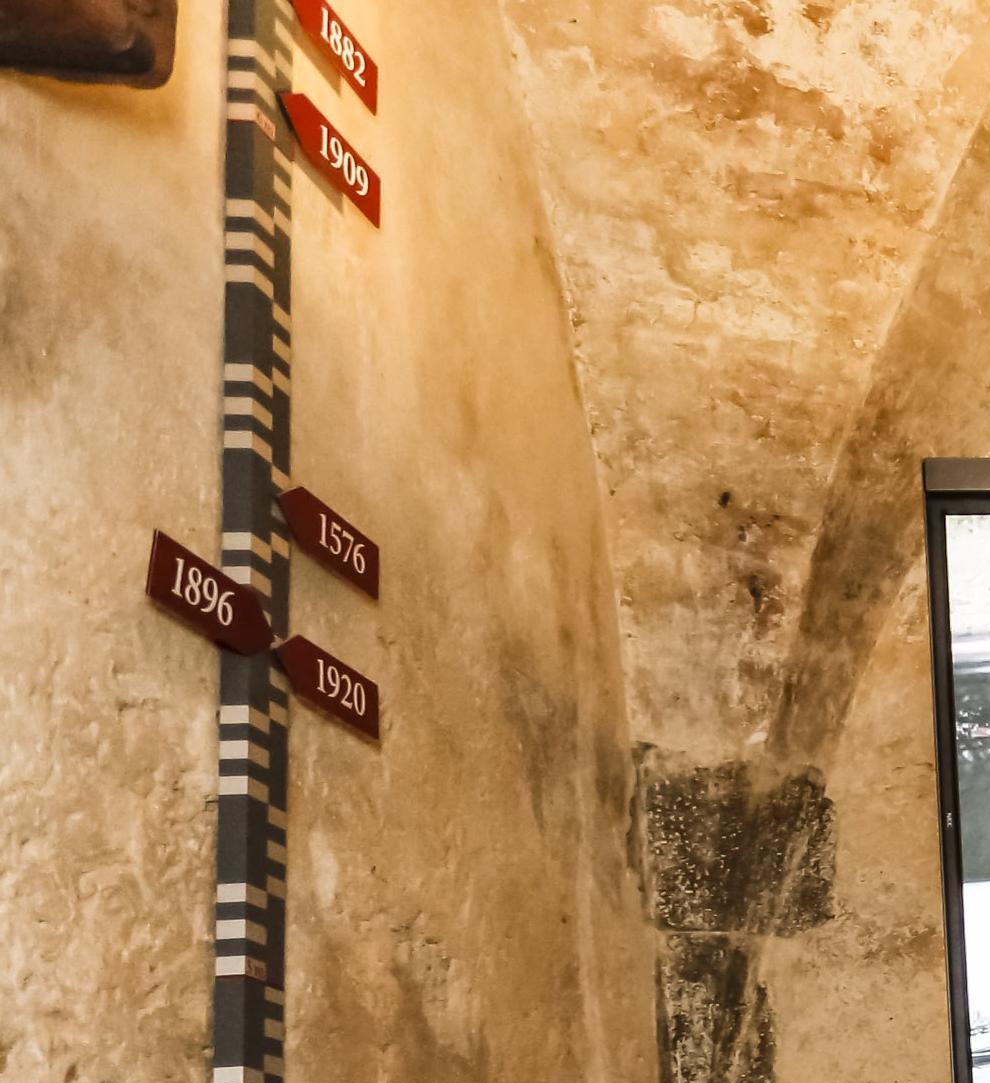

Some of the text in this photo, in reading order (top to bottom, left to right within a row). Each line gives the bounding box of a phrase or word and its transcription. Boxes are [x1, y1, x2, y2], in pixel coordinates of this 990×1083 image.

[320, 7, 366, 87] 1882
[319, 124, 369, 196] 1909
[319, 513, 366, 574] 1576
[171, 557, 235, 626] 1896
[316, 658, 366, 716] 1920
